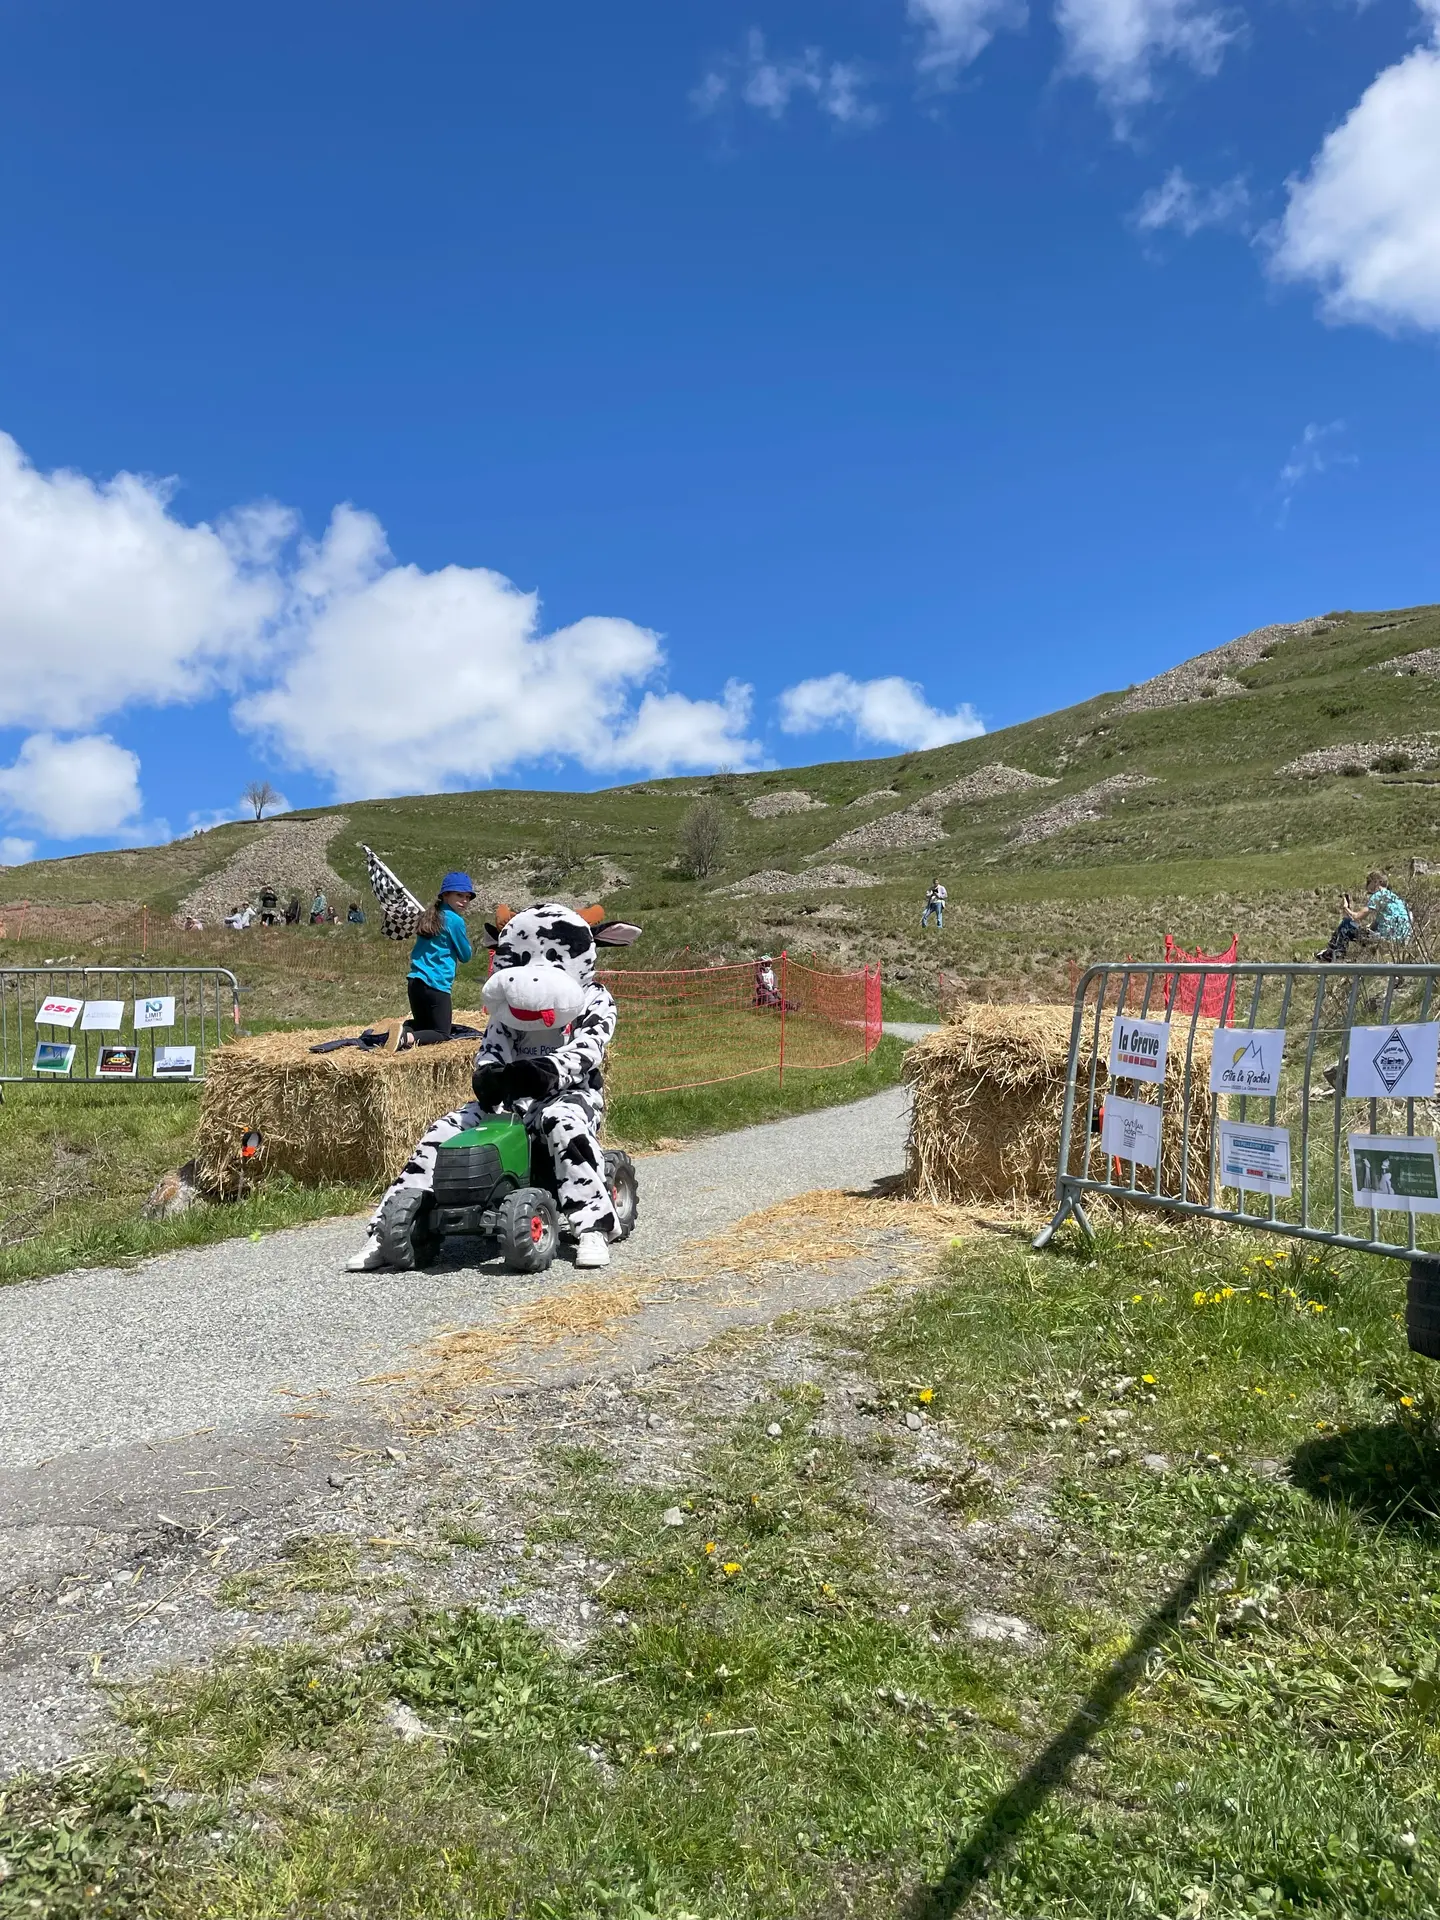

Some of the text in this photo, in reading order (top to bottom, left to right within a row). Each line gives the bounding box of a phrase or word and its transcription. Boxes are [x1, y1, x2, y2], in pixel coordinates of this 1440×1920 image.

[1118, 1025, 1159, 1056] la Grave
[1246, 1070, 1270, 1085] Rocher
